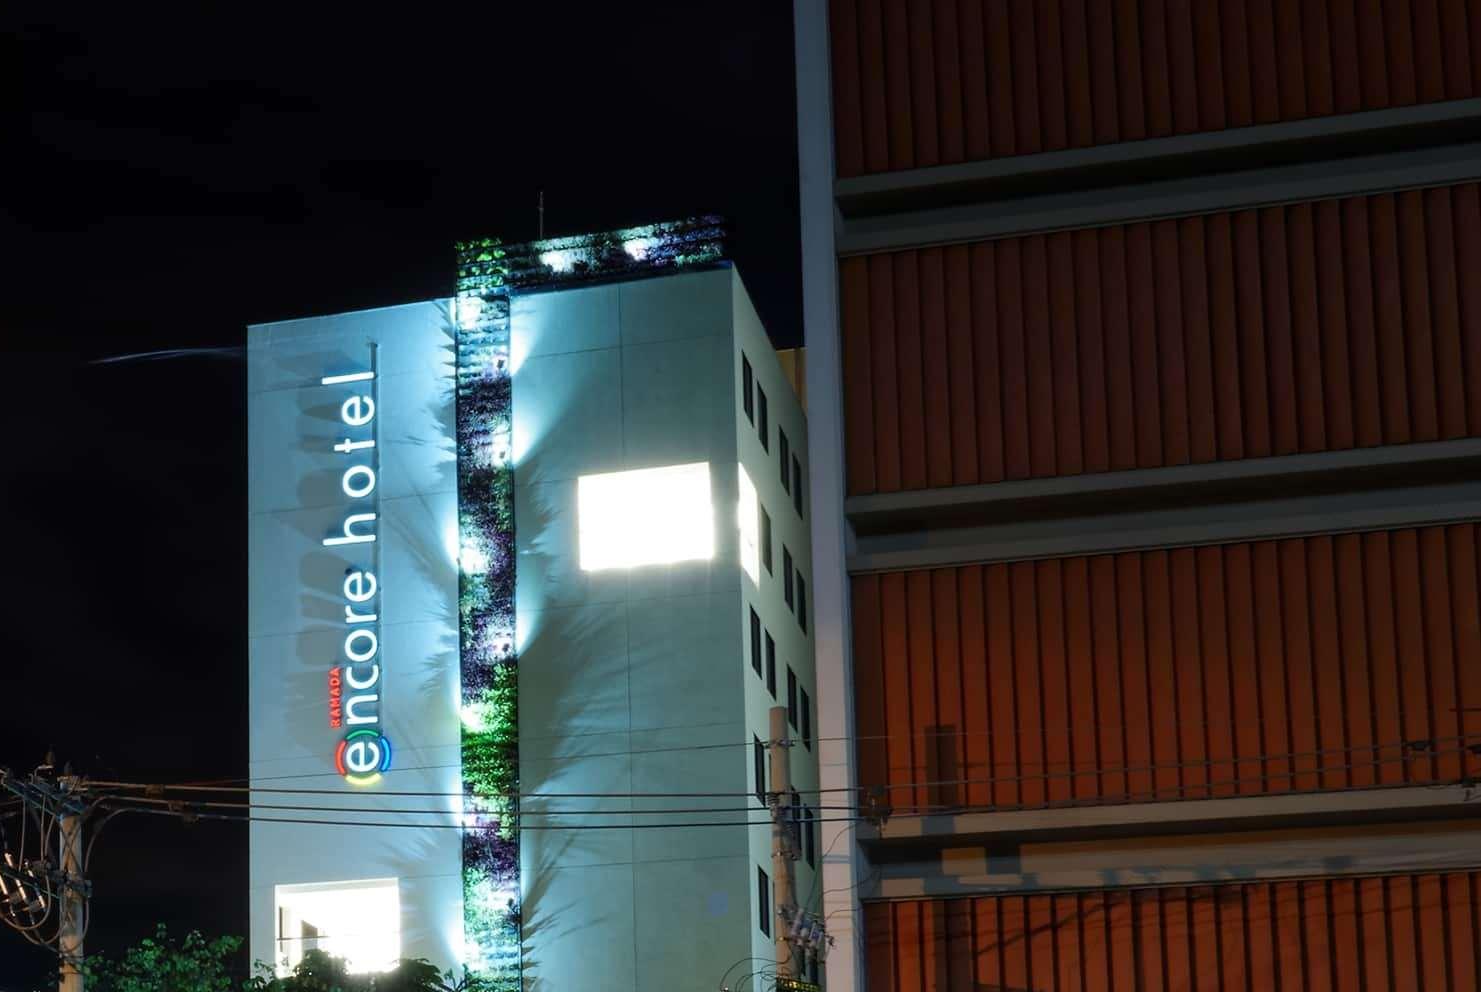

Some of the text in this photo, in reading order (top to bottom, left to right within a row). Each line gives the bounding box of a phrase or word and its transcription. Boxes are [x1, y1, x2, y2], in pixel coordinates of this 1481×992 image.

[321, 371, 380, 774] encore hotel
[328, 666, 341, 728] RAMADA
